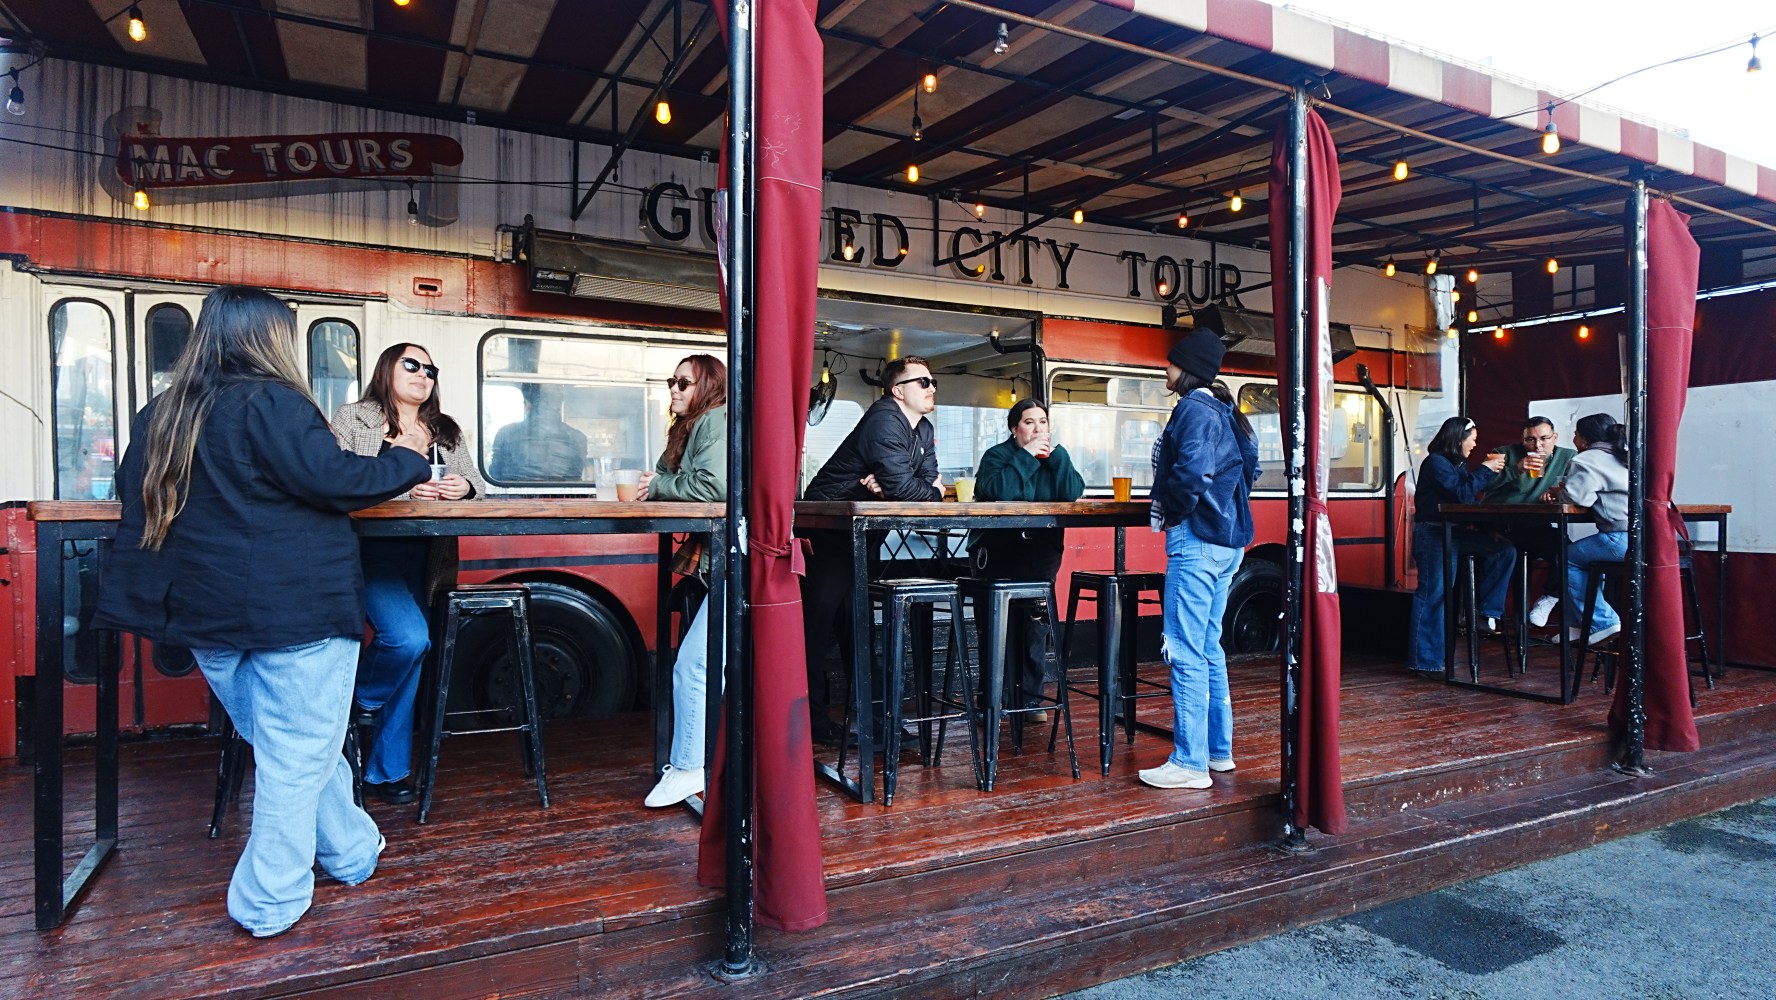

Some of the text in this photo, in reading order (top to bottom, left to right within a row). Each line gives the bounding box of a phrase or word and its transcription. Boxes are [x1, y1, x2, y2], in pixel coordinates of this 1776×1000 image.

[131, 138, 414, 181] MAC TOURS
[648, 182, 1245, 309] GED CITY TOUR
